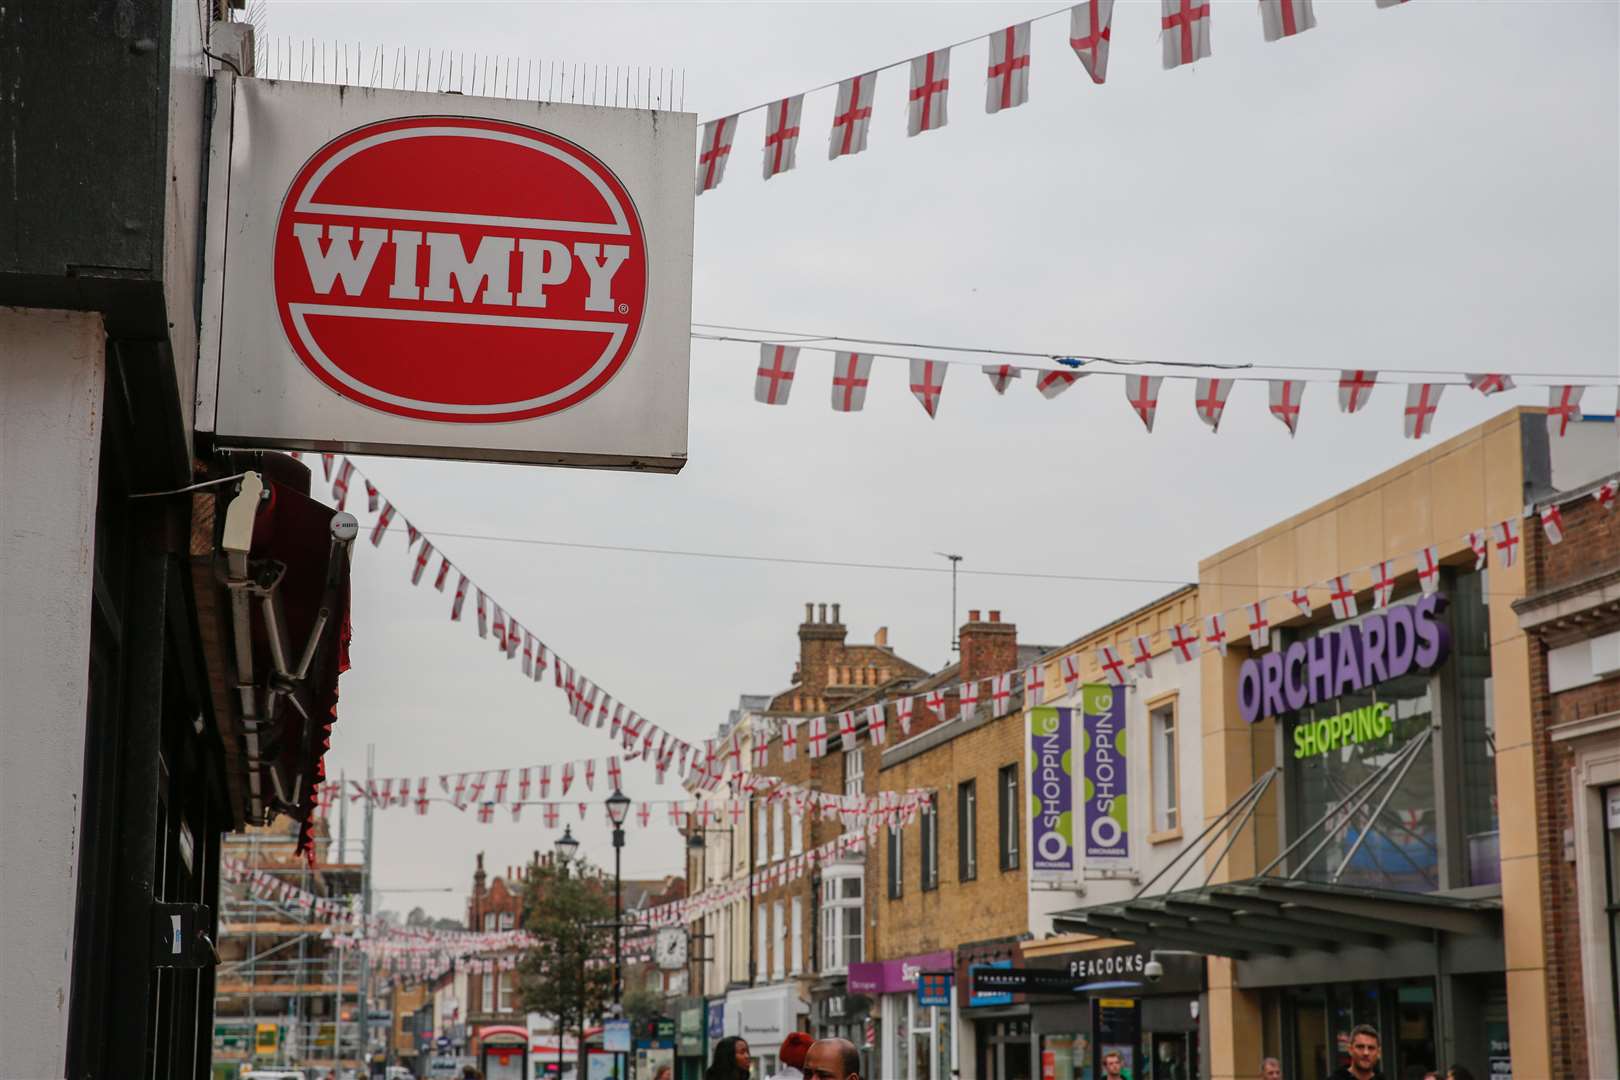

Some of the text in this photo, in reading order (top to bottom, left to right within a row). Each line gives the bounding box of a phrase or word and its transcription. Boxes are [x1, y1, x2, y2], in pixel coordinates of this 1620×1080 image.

[293, 223, 630, 312] WIMPY
[1238, 592, 1443, 723] ORCHARDS
[1043, 716, 1060, 828] SHOPPING
[1095, 695, 1115, 812] SHOPPING
[1294, 702, 1392, 759] SHOPPING
[1070, 954, 1144, 978] PEACOCKS
